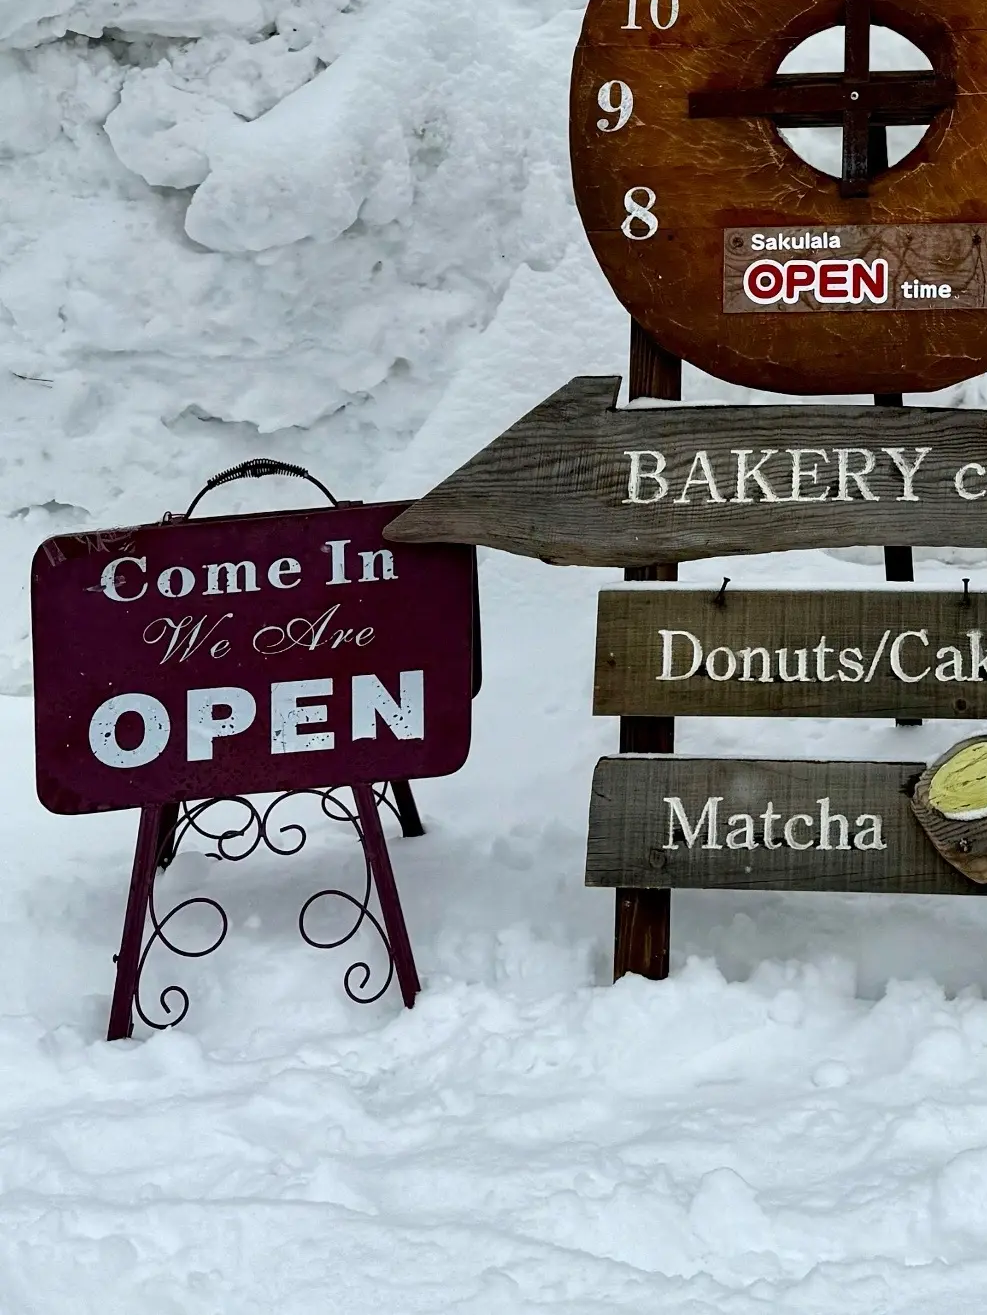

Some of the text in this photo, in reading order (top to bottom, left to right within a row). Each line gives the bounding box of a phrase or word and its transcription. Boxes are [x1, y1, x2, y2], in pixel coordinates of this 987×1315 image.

[596, 79, 634, 133] 9
[620, 186, 658, 240] 8
[750, 231, 841, 251] Sakulala
[743, 257, 952, 305] OPEN time
[622, 446, 933, 505] BAKERY
[100, 539, 399, 602] Come In
[142, 603, 376, 666] We Are
[88, 669, 425, 769] OPEN
[661, 795, 887, 853] Matcha
